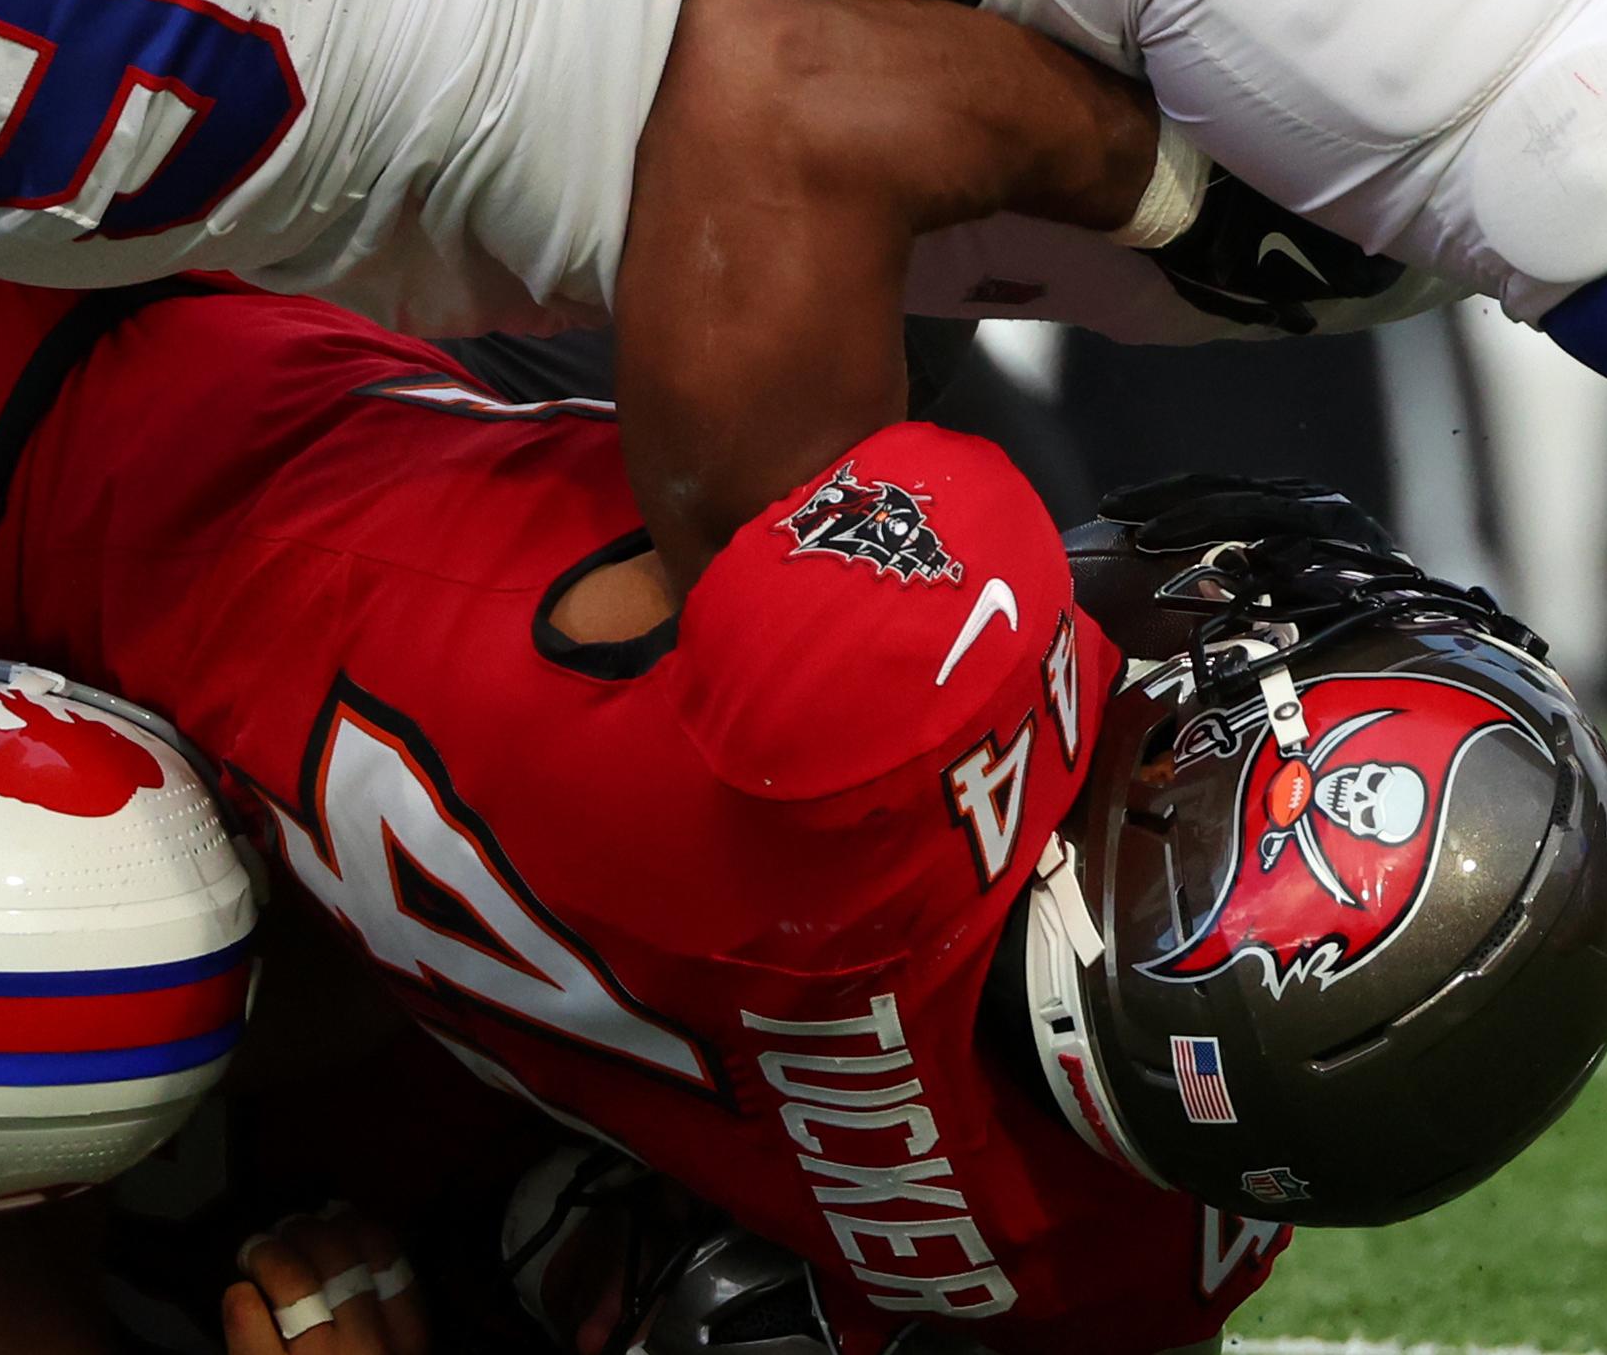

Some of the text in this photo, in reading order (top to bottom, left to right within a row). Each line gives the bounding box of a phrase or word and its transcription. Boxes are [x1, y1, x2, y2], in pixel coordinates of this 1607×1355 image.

[222, 666, 736, 1166] 4
[941, 609, 1084, 896] 44
[740, 992, 1019, 1320] TUCKER
